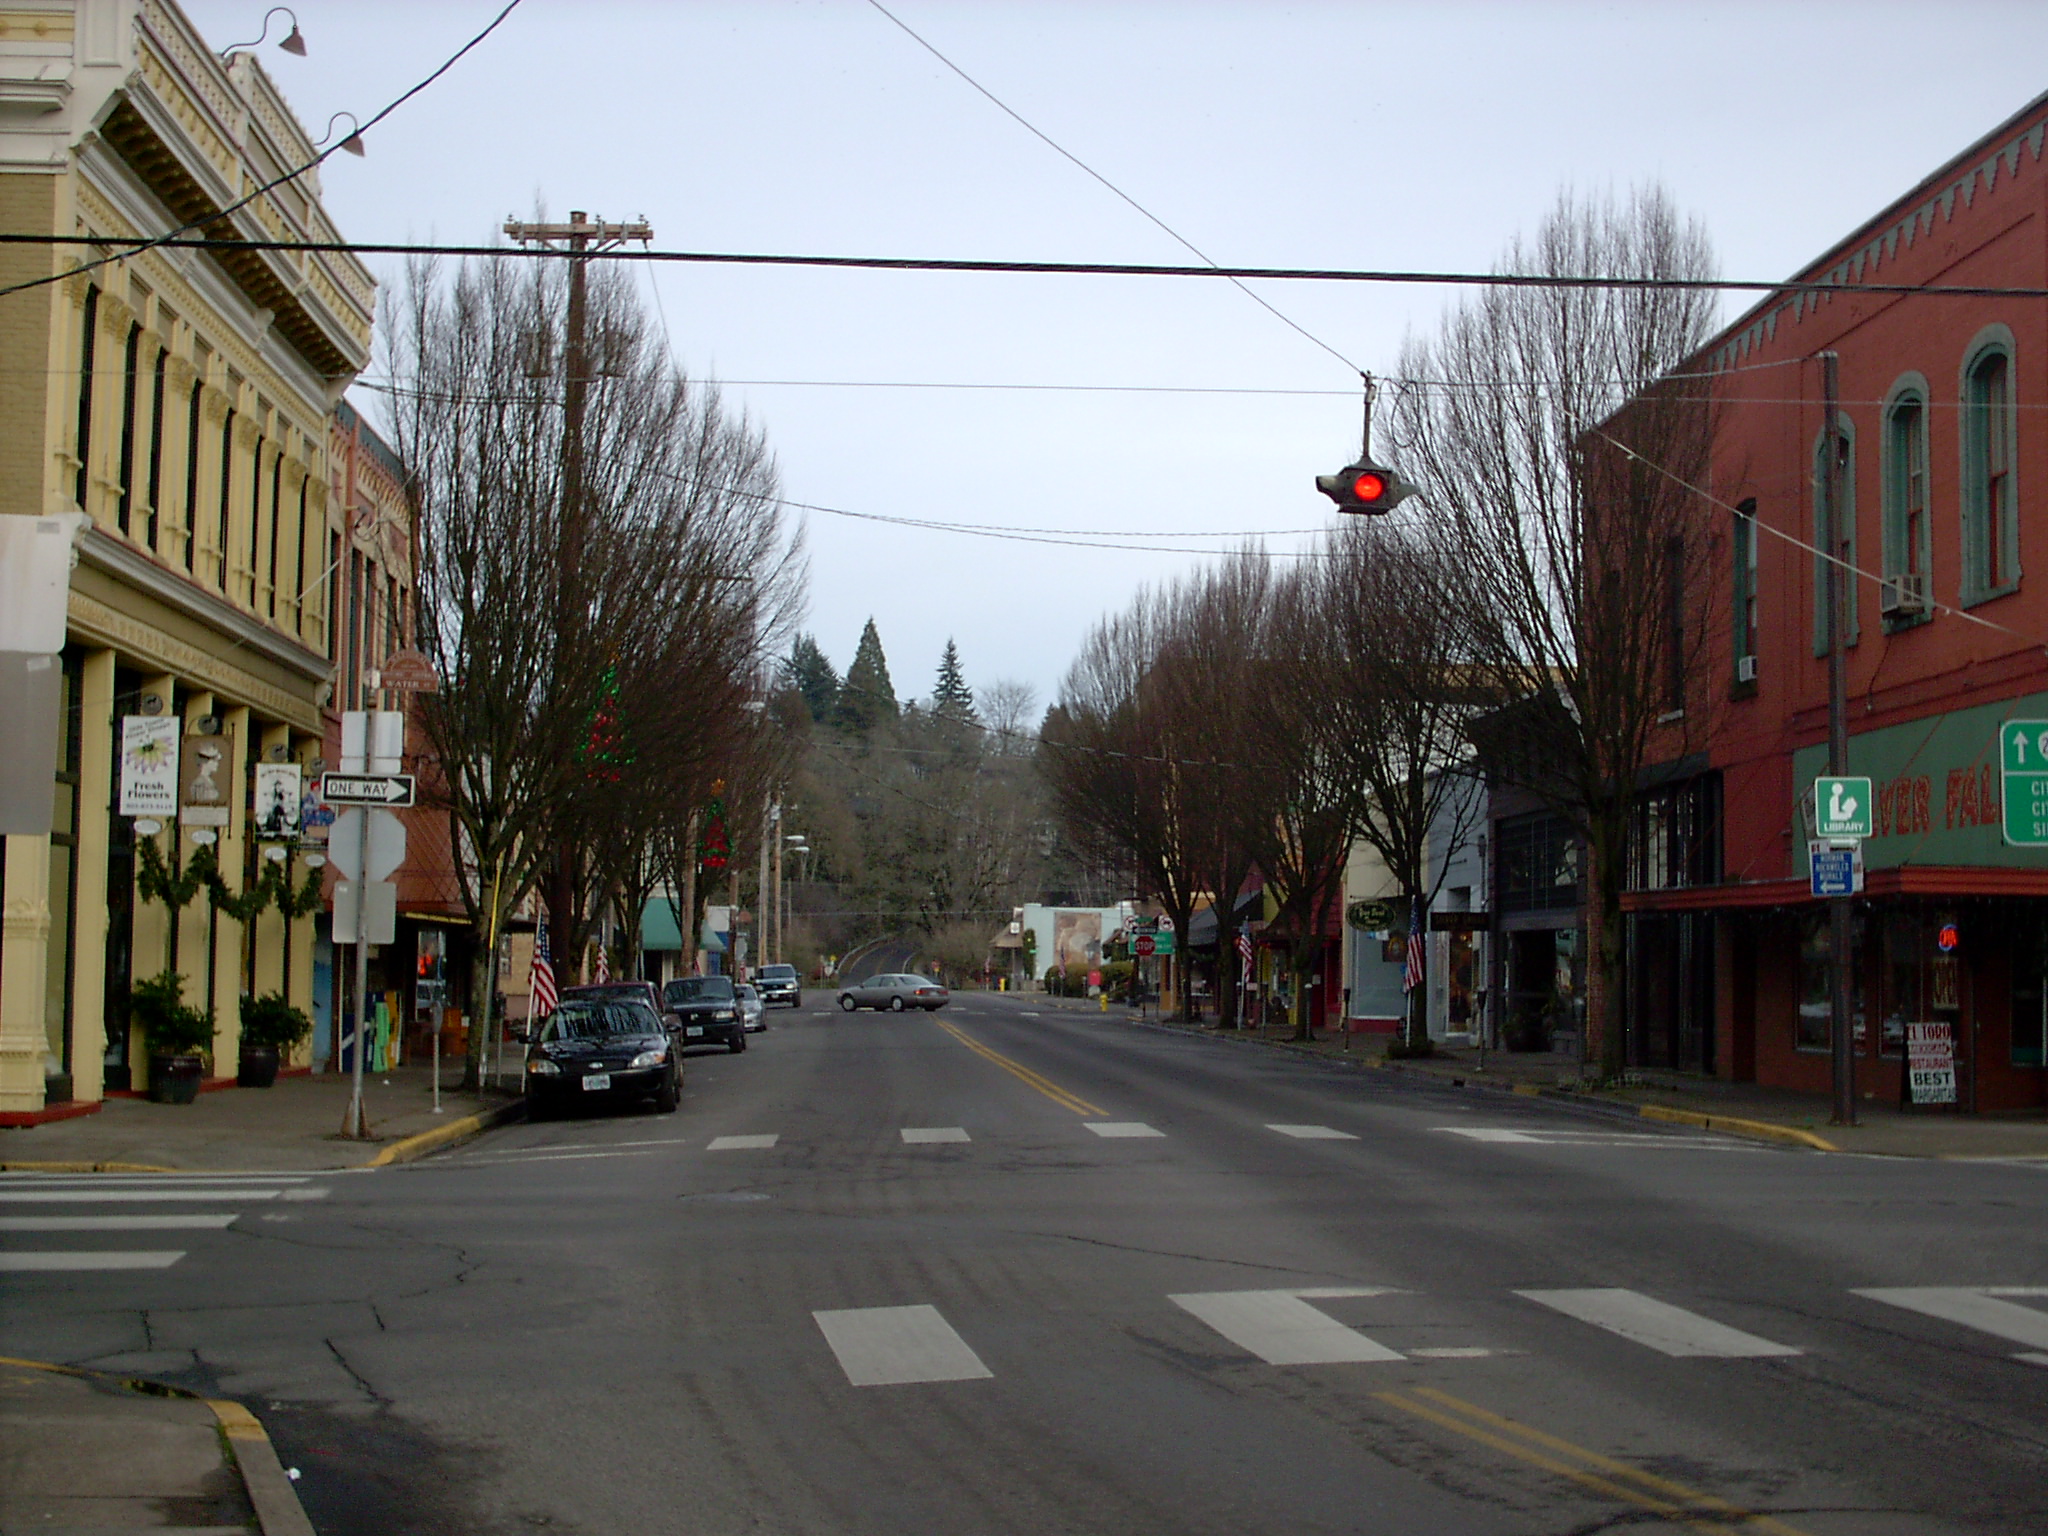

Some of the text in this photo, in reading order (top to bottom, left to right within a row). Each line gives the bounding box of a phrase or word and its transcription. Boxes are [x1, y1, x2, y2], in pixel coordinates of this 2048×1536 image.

[385, 680, 420, 688] WATER
[134, 782, 164, 790] Fresh
[329, 782, 388, 795] ONE WAY
[128, 790, 170, 799] Flowers
[1871, 763, 2002, 839] VER FAL
[1824, 822, 1864, 832] LIBRARY
[1135, 941, 1155, 951] STOP
[1914, 1072, 1951, 1085] BEST
